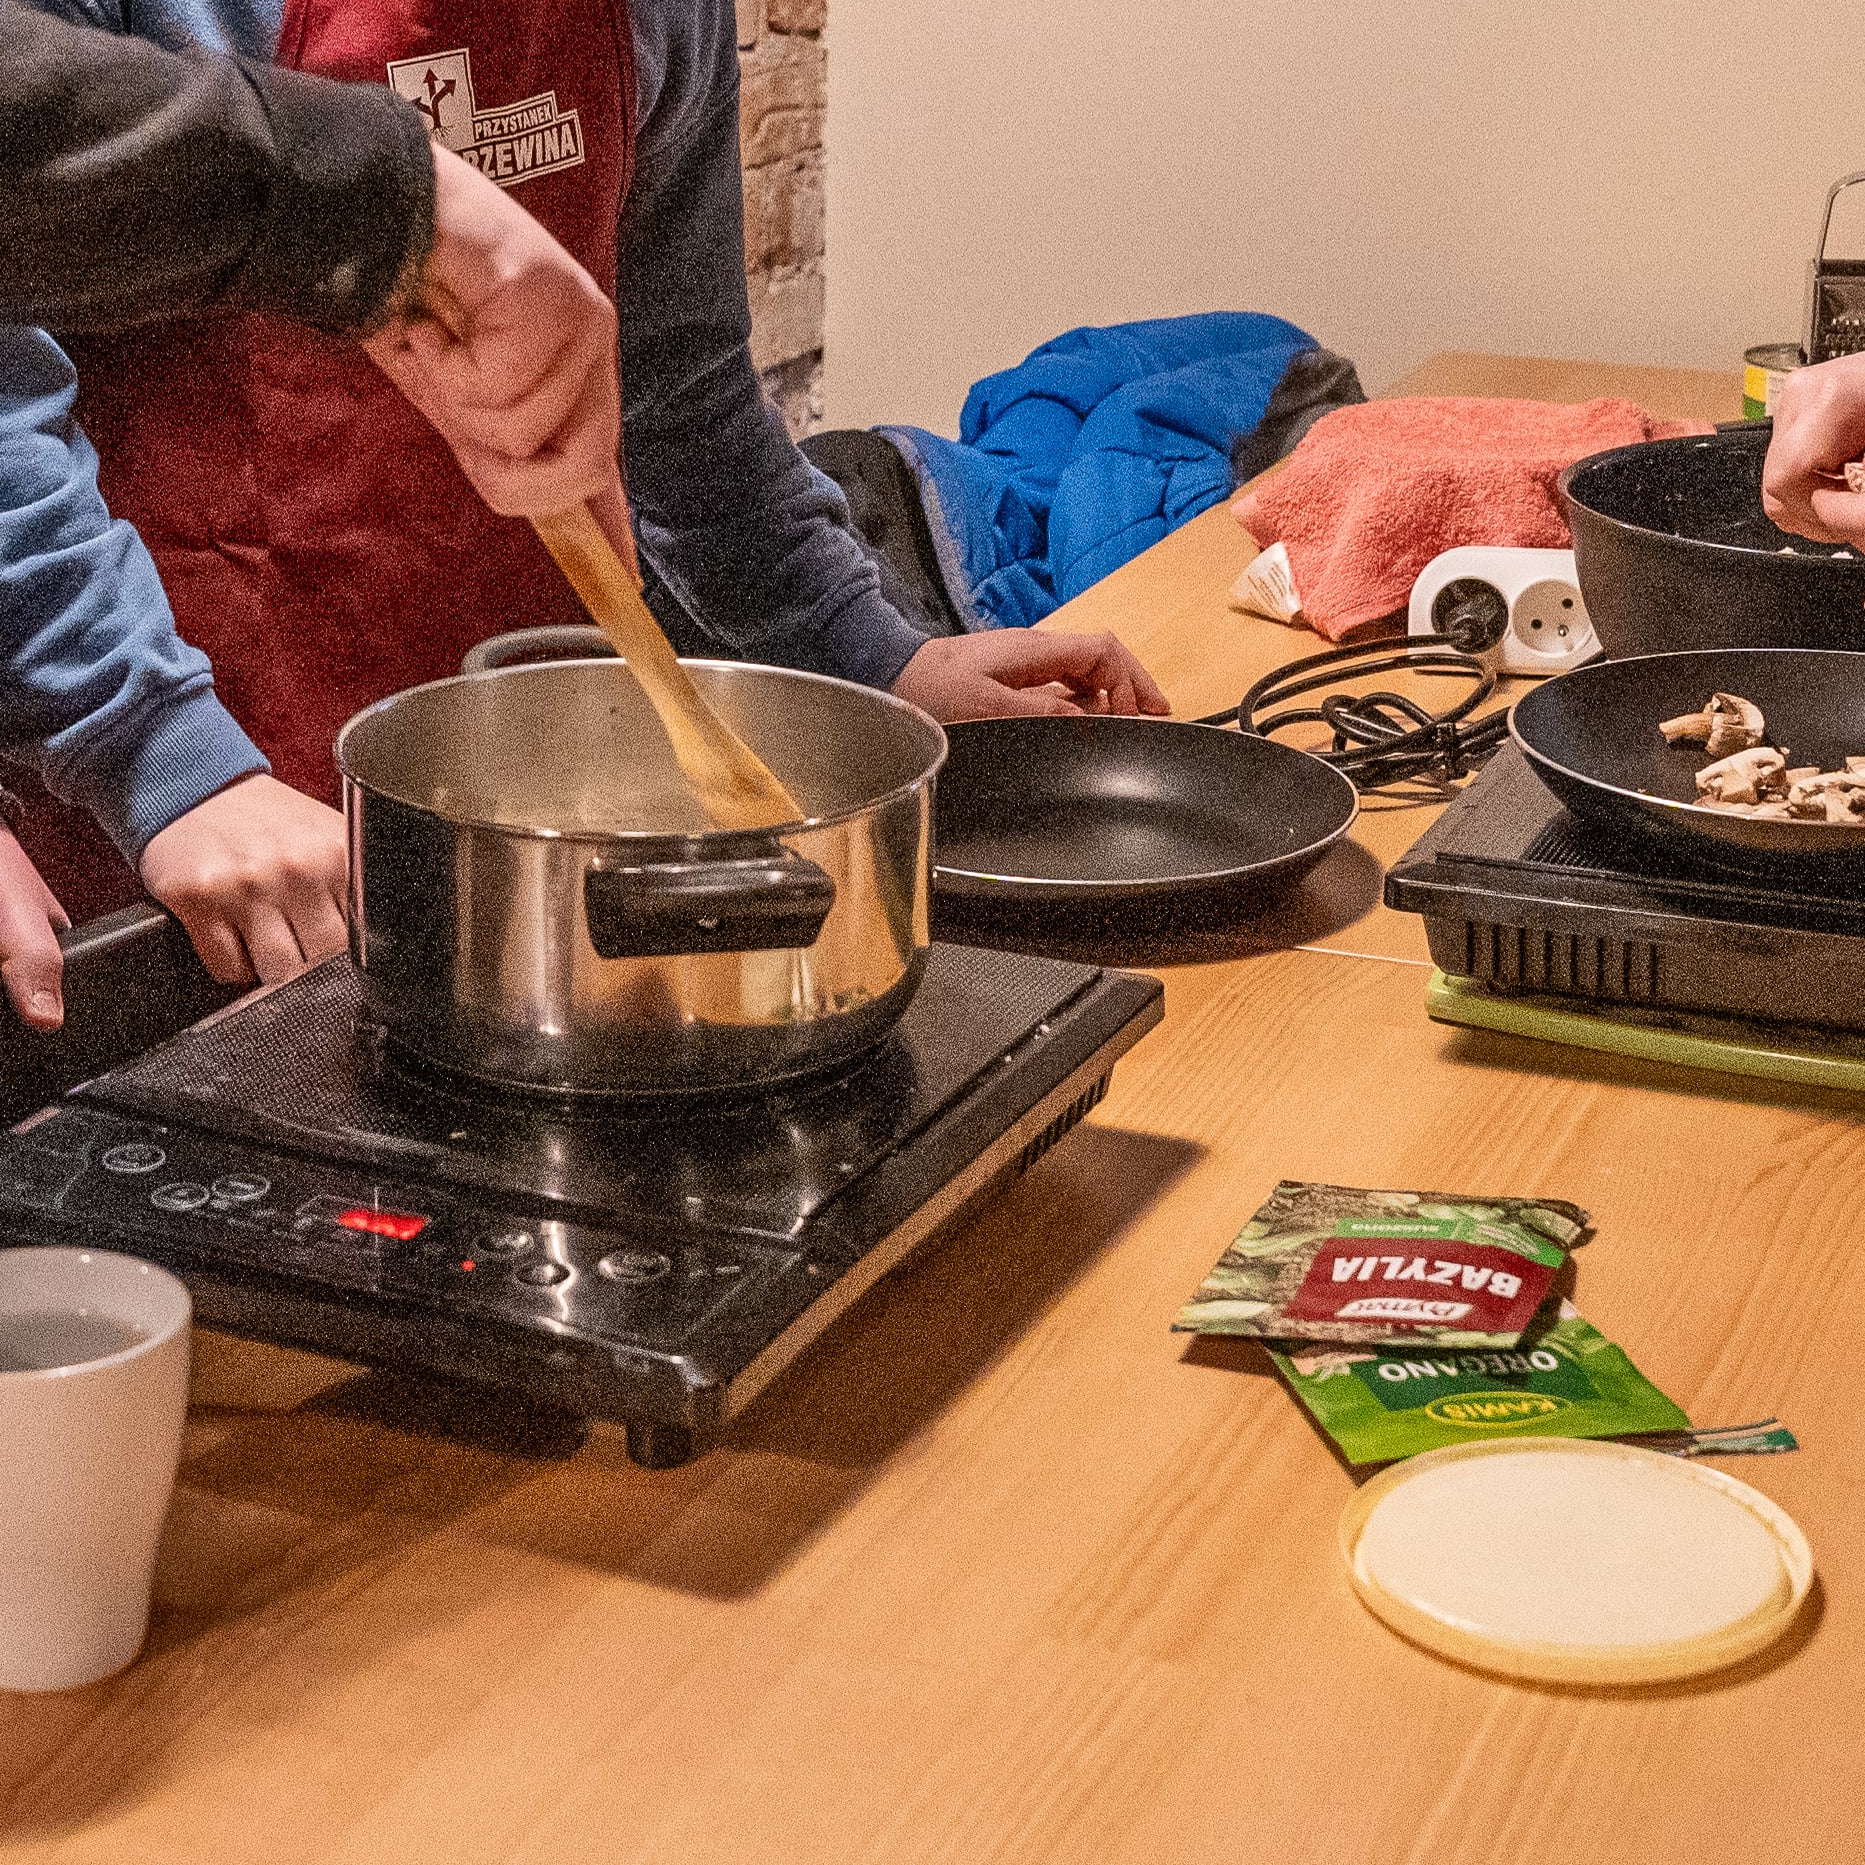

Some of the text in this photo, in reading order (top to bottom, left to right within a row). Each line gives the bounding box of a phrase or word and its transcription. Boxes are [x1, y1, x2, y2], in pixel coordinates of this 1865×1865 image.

[474, 102, 552, 140] PRZYSTANEK
[462, 123, 577, 178] RZEWINA
[1331, 1255, 1523, 1299] BAZYLIA
[1377, 1350, 1559, 1382] OREGANO
[1442, 1398, 1558, 1422] KAMIS
